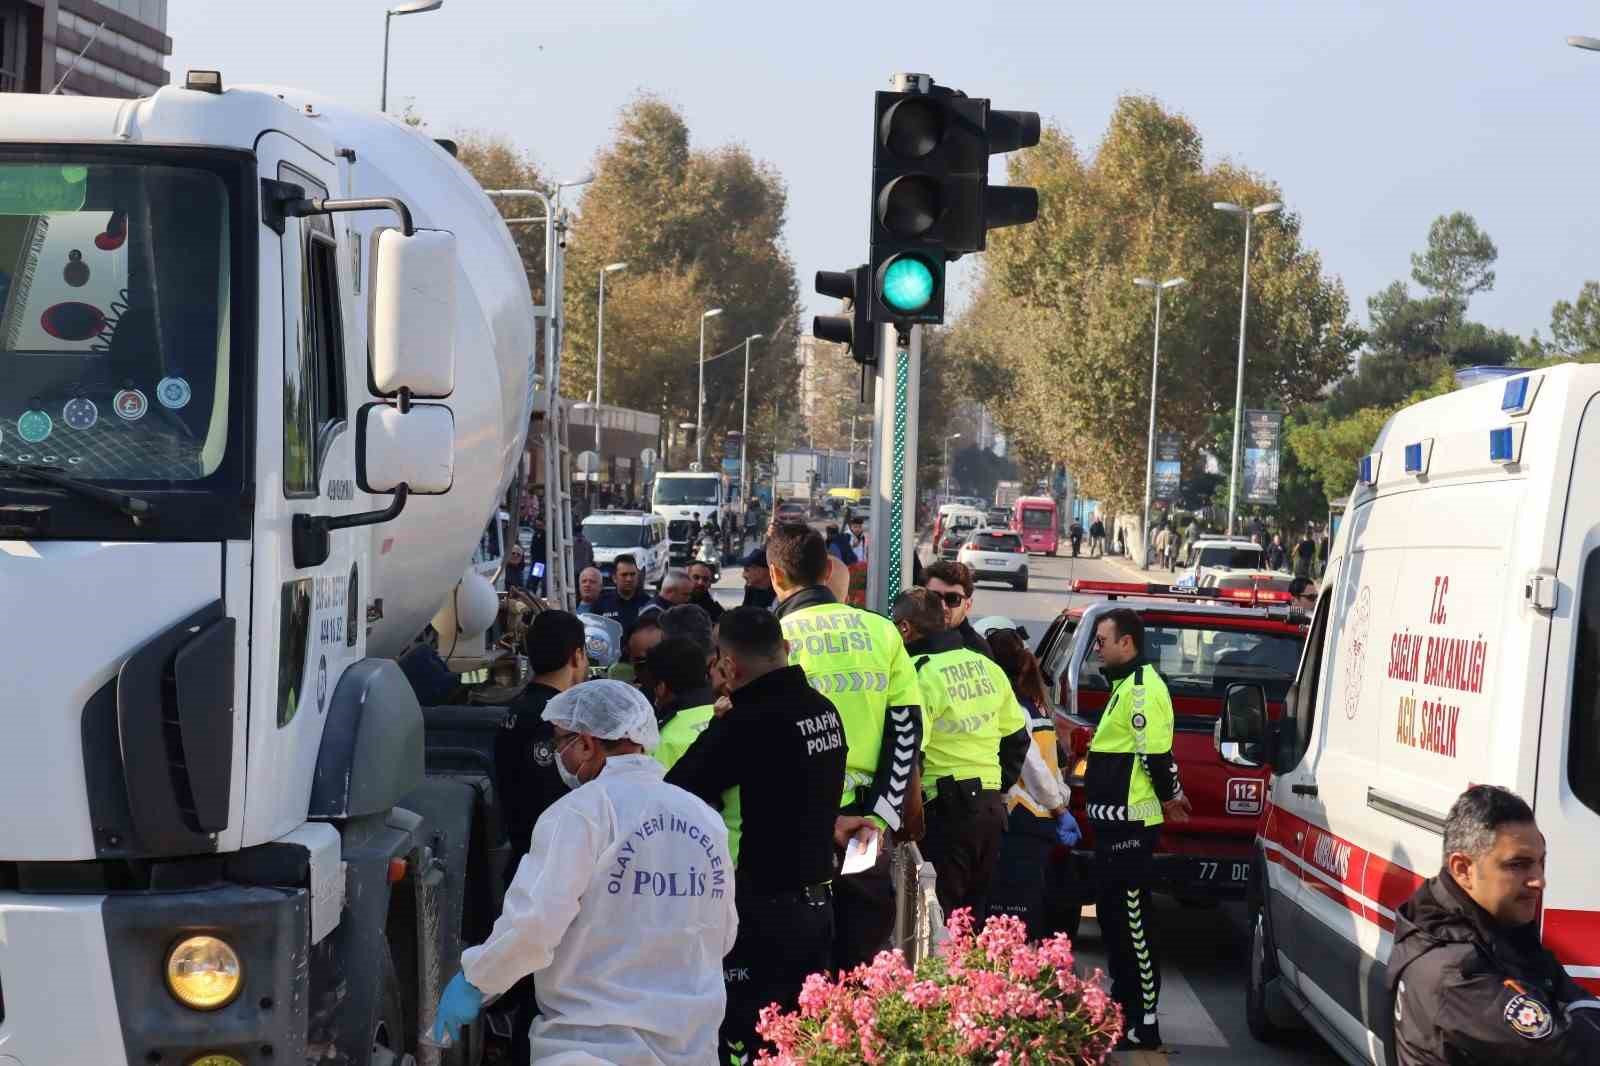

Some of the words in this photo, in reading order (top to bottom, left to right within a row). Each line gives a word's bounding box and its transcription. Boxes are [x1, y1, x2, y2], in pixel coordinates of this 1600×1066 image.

[784, 613, 867, 637] TRAFİK
[788, 631, 873, 661] POLİSİ
[1388, 626, 1423, 683] SAĞLIK
[1424, 632, 1487, 694] BAKANLIĞI
[796, 711, 840, 736] TRAFİK
[1420, 696, 1460, 758] SAĞLIK
[807, 730, 842, 755] POLİSİ
[1233, 783, 1257, 799] 112
[607, 841, 635, 894] OLAY
[635, 814, 664, 840] YERİ
[670, 814, 725, 899] İNCELEME
[1312, 831, 1351, 880] AMBULANS
[632, 866, 706, 897] POLİS
[1199, 862, 1218, 880] 77
